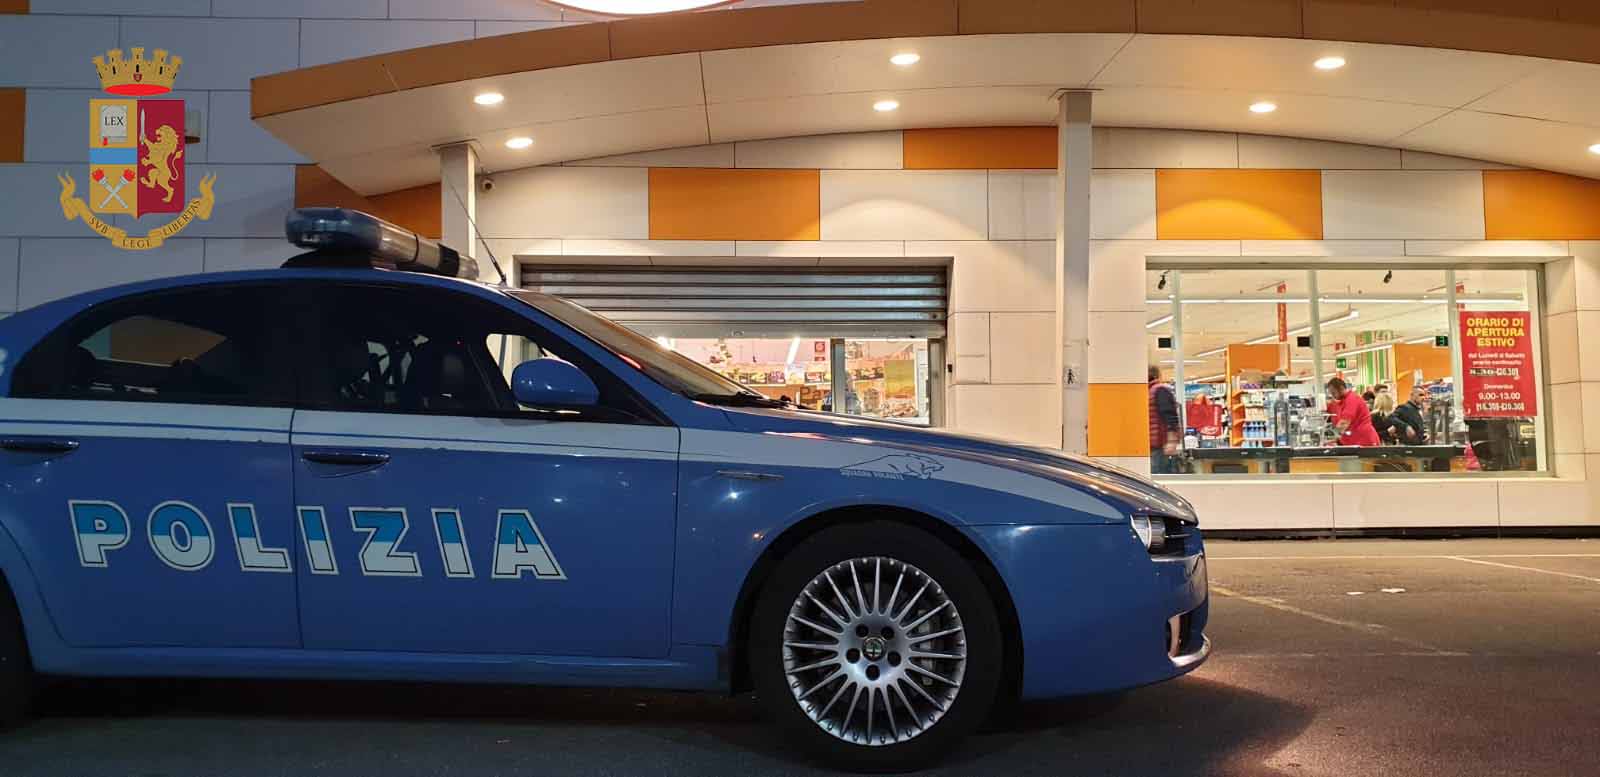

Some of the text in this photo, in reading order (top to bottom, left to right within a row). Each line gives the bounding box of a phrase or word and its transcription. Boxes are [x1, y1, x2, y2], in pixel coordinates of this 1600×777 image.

[1466, 318, 1524, 328] ORARIO DI
[1466, 328, 1525, 337] APERTURA
[1476, 337, 1515, 347] ESTIVO
[1478, 392, 1521, 400] 9.00-13.00
[69, 499, 568, 580] POLIZIA
